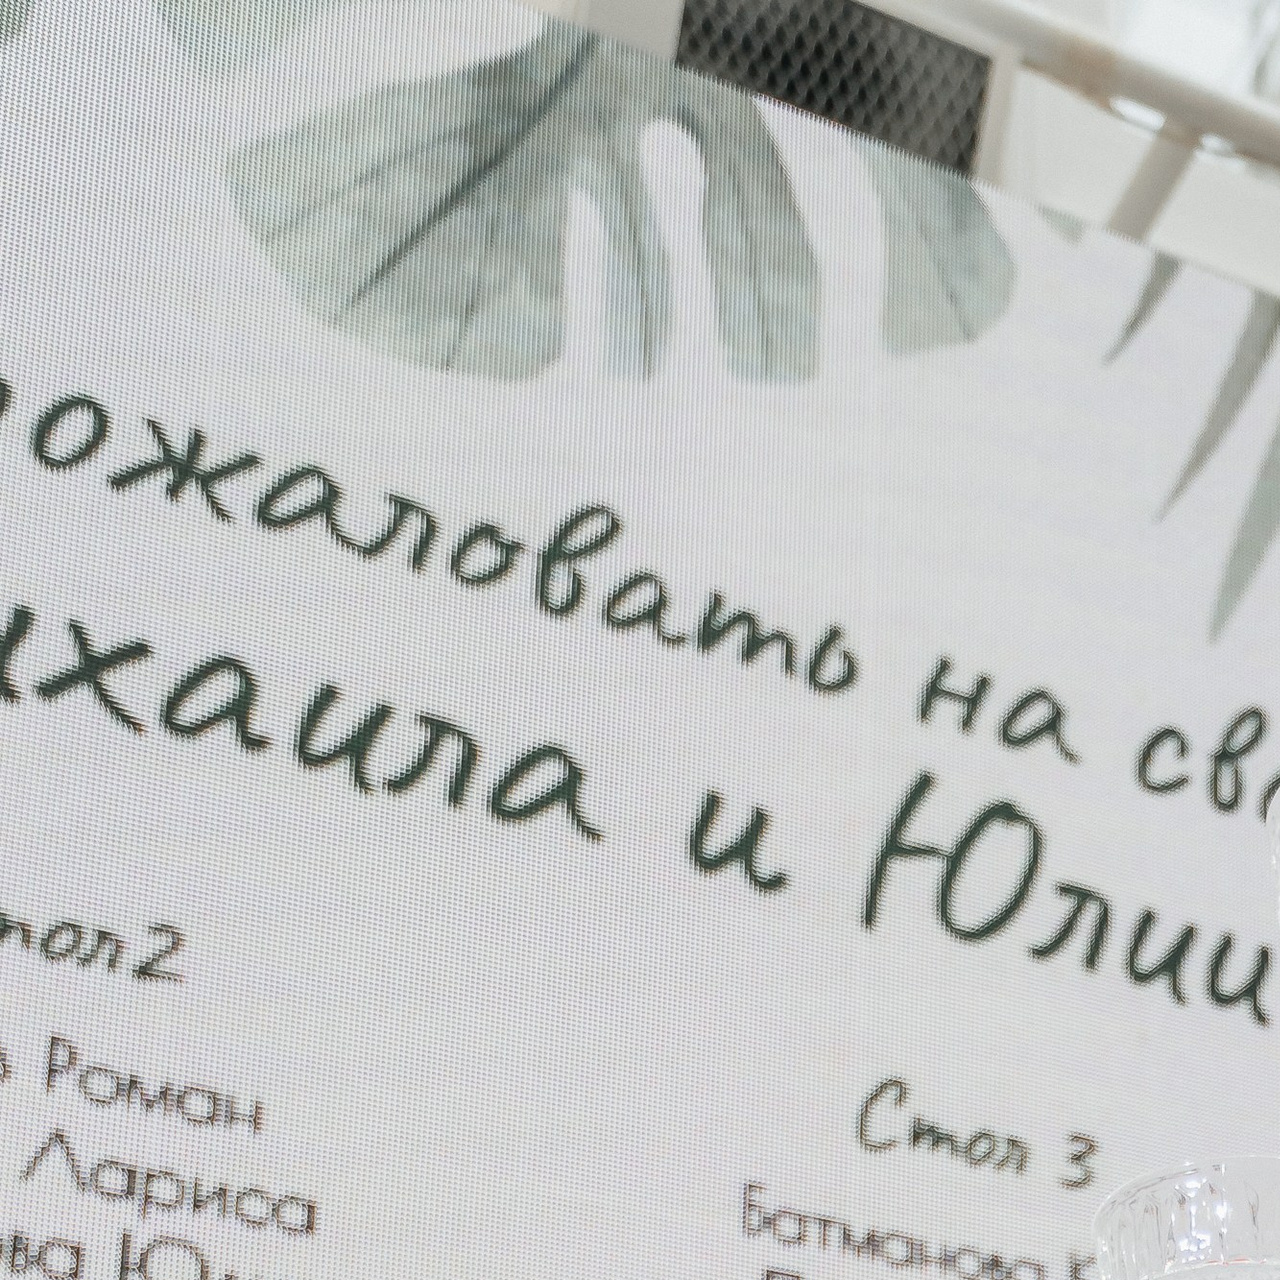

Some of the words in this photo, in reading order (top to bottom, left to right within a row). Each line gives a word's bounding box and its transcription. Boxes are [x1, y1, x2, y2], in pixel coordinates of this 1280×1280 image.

[0, 378, 860, 694] ожаловать
[918, 656, 1080, 764] на
[688, 790, 788, 893] и
[861, 770, 1273, 1028] Юлии
[46, 1034, 265, 1136] Роман
[856, 1075, 1030, 1176] Стол
[1058, 1130, 1101, 1190] 3
[20, 1127, 320, 1236] Лариса
